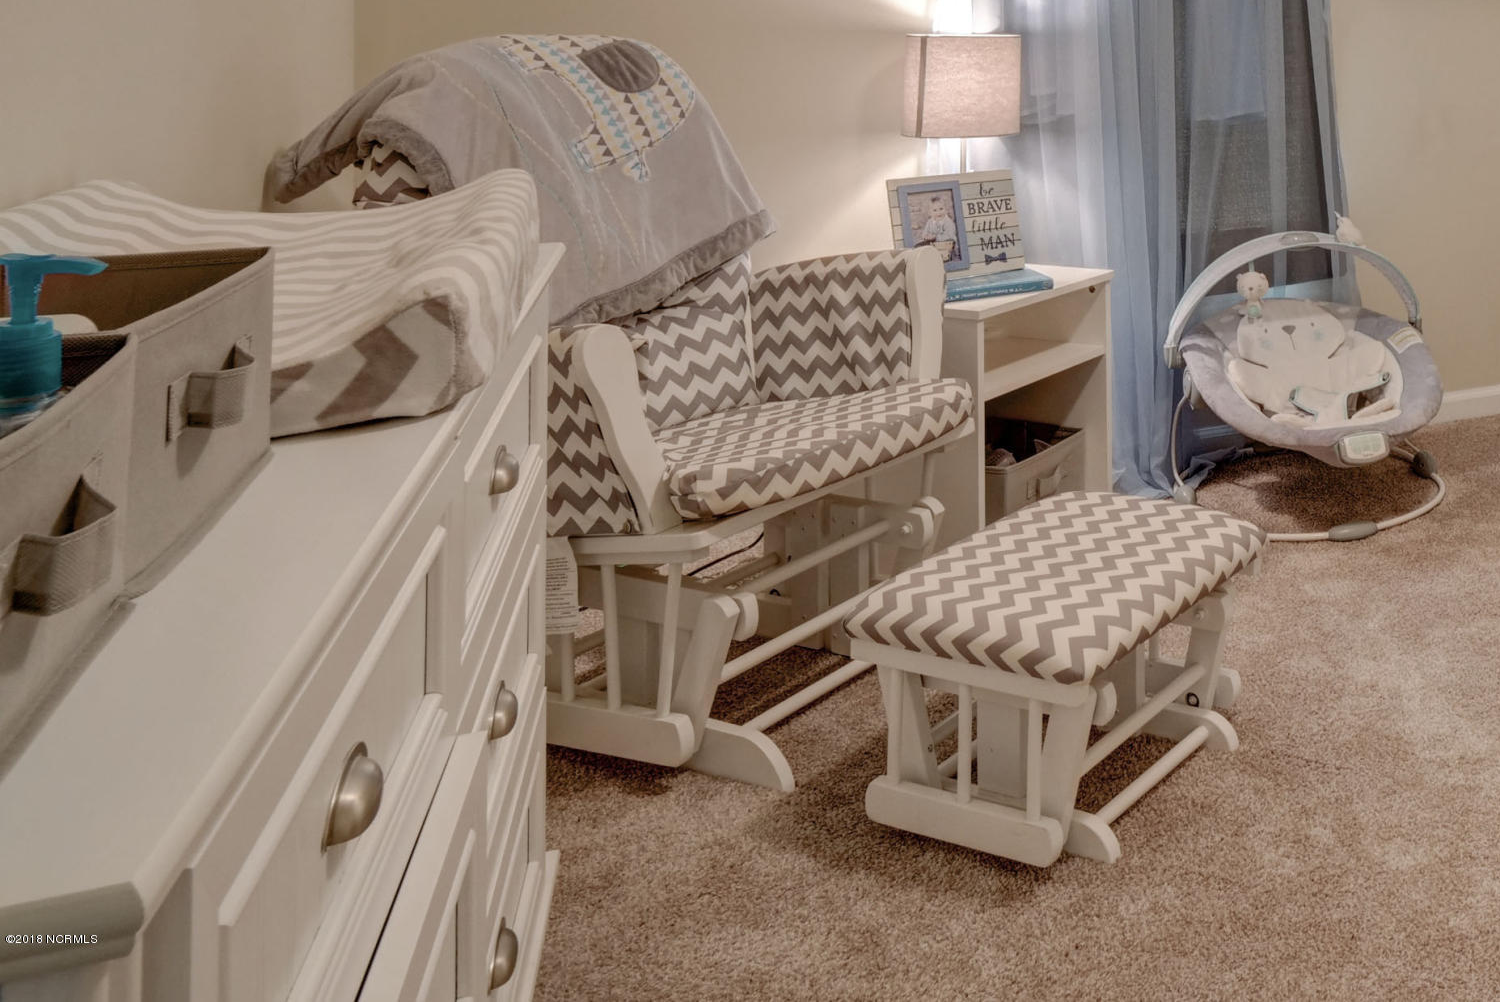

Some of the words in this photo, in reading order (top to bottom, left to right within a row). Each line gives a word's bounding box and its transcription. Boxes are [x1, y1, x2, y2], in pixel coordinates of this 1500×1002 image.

[979, 183, 995, 198] be
[967, 198, 1013, 216] BRAVE
[971, 217, 1007, 234] little
[980, 233, 1016, 252] MAN
